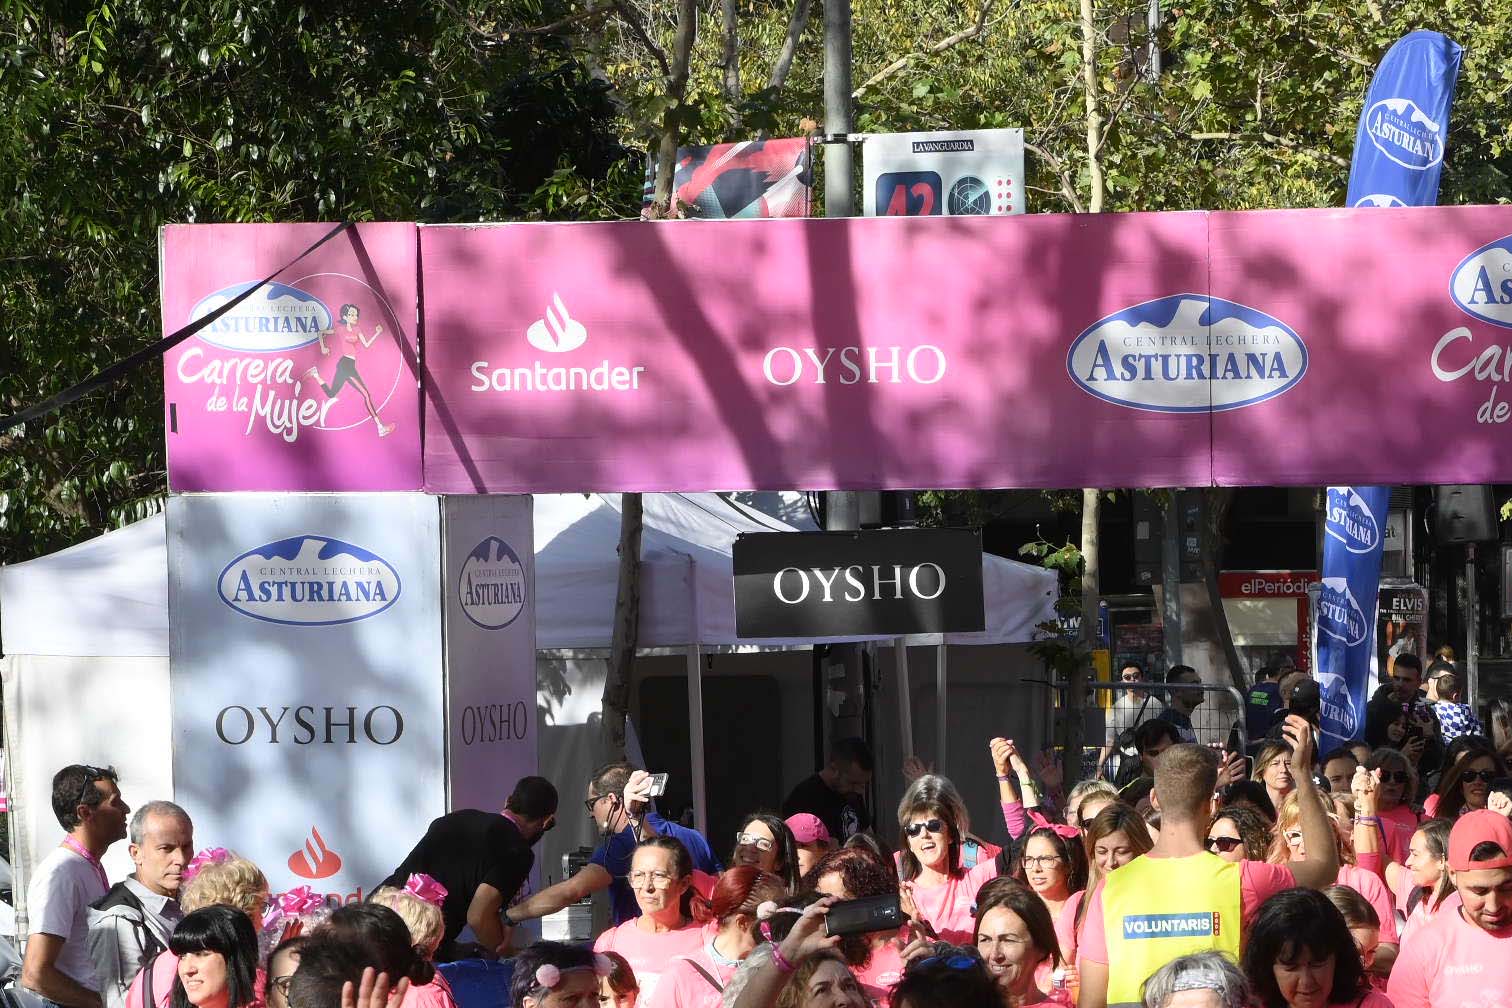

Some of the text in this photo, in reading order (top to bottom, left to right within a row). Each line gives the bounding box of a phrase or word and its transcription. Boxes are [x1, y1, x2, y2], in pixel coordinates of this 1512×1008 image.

[1123, 335, 1281, 347] CENTRAL LECHERA
[177, 347, 294, 385] Carrera
[471, 360, 644, 391] Santander
[762, 345, 947, 386] OYSHO
[1086, 339, 1289, 383] ASTURIANA
[207, 386, 248, 412] de la
[245, 380, 339, 443] Mujer
[1477, 384, 1510, 423] de
[231, 569, 387, 602] ASTURIANA
[260, 566, 381, 576] CENTRAL LECHERA
[464, 569, 522, 607] ASTURIANA
[773, 562, 946, 604] OYSHO
[1393, 598, 1424, 610] ELVIS
[216, 705, 403, 745] OYSHO
[462, 701, 527, 746] OYSHO
[1125, 918, 1209, 934] VOLUNTARIS
